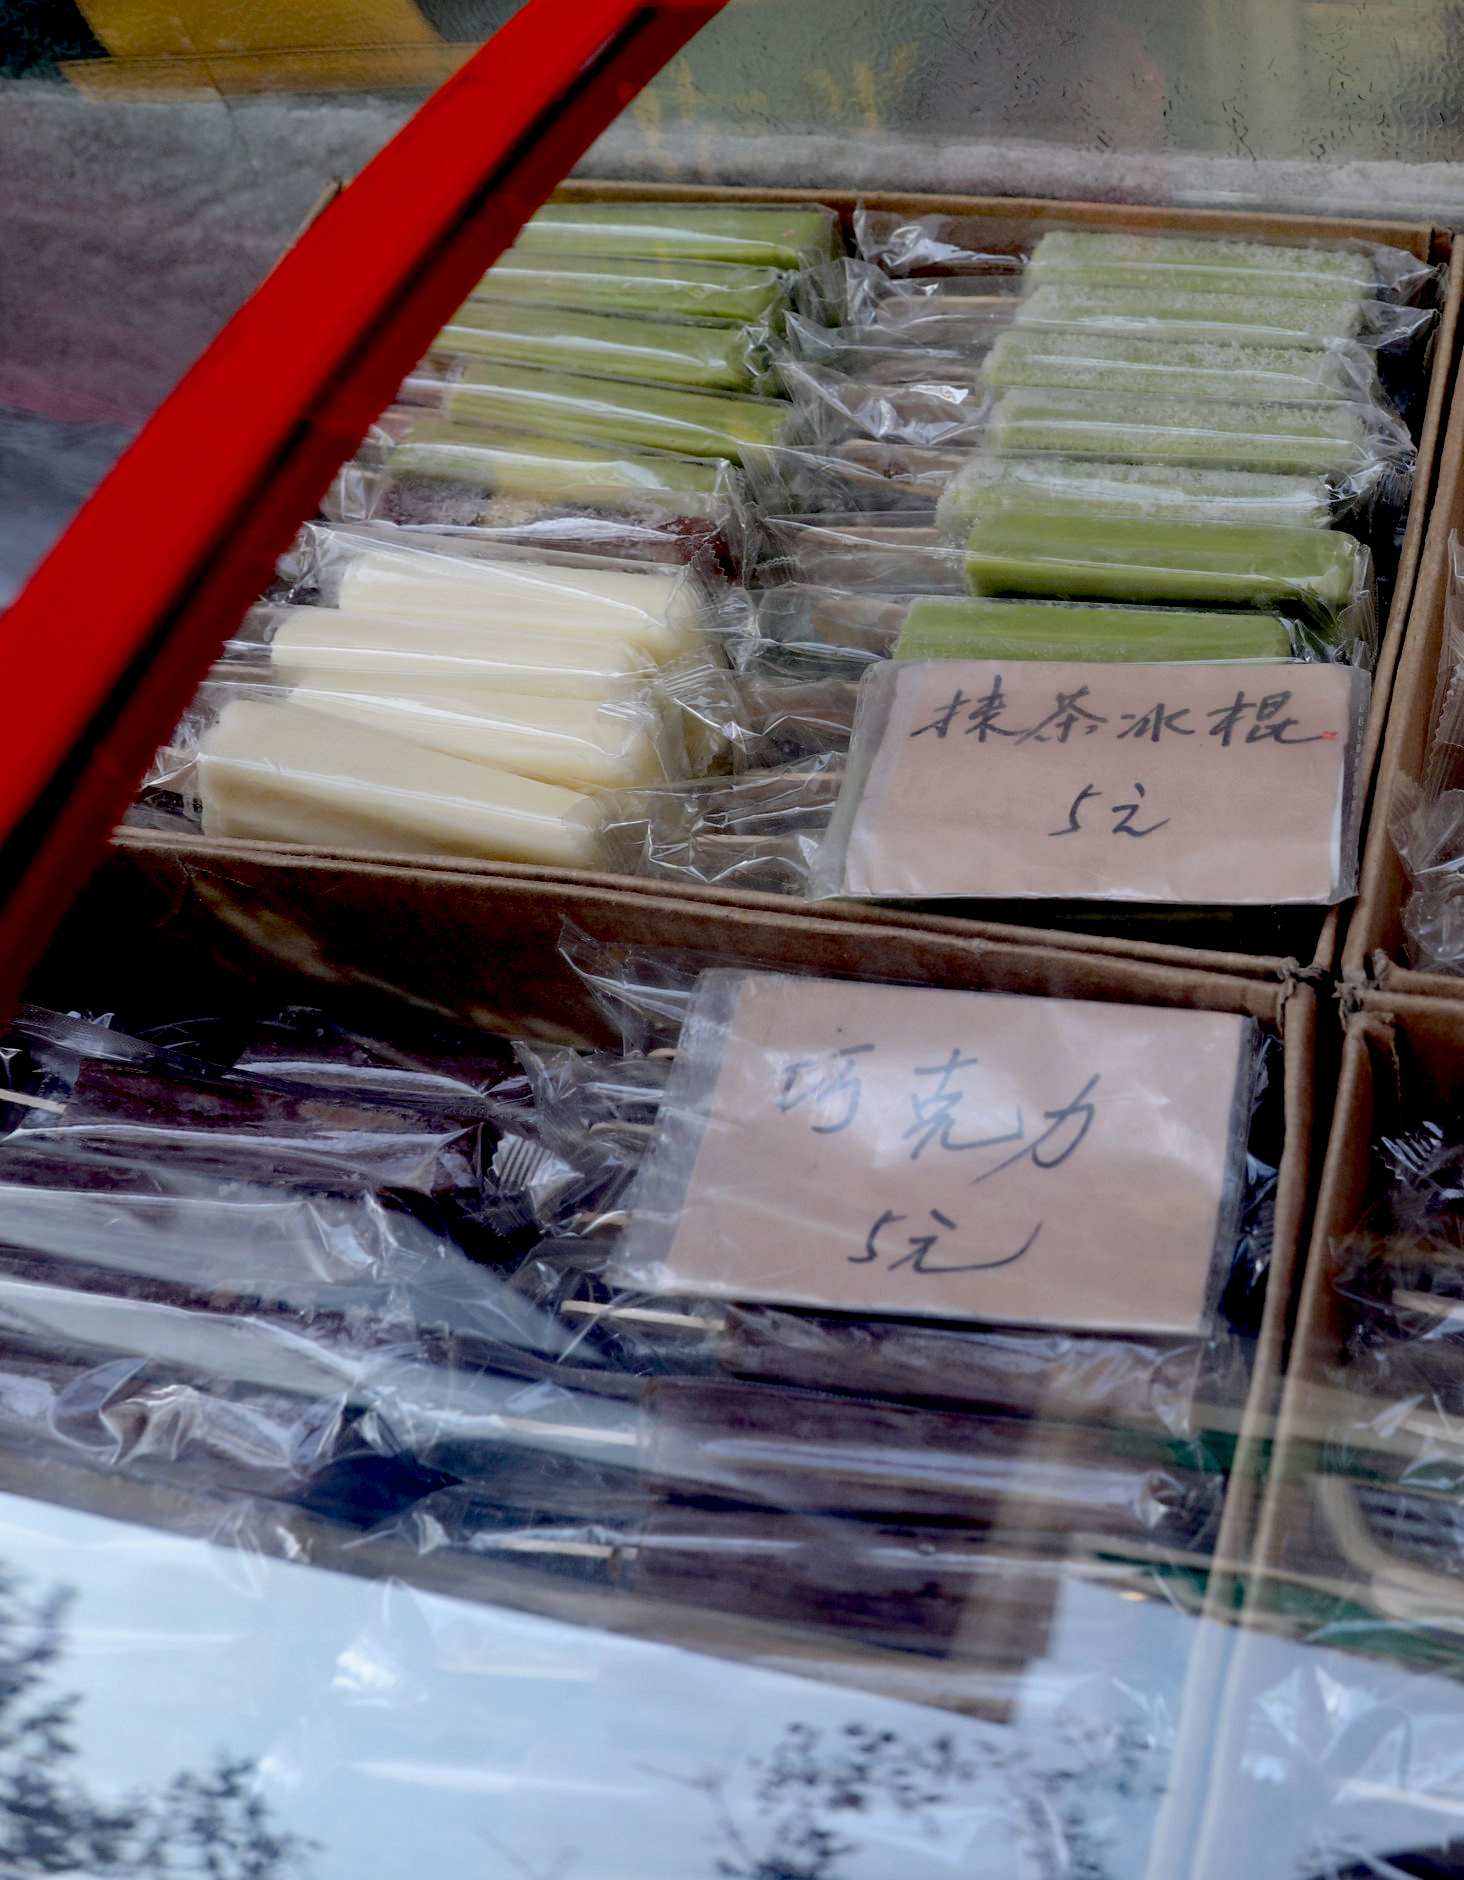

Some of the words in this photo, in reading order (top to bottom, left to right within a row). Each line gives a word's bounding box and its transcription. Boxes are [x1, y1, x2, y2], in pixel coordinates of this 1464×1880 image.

[909, 674, 1332, 748] 抹茶冰棍
[1047, 782, 1171, 838] 5元
[775, 1043, 1102, 1186] 巧克力
[846, 1208, 1044, 1274] 5元
